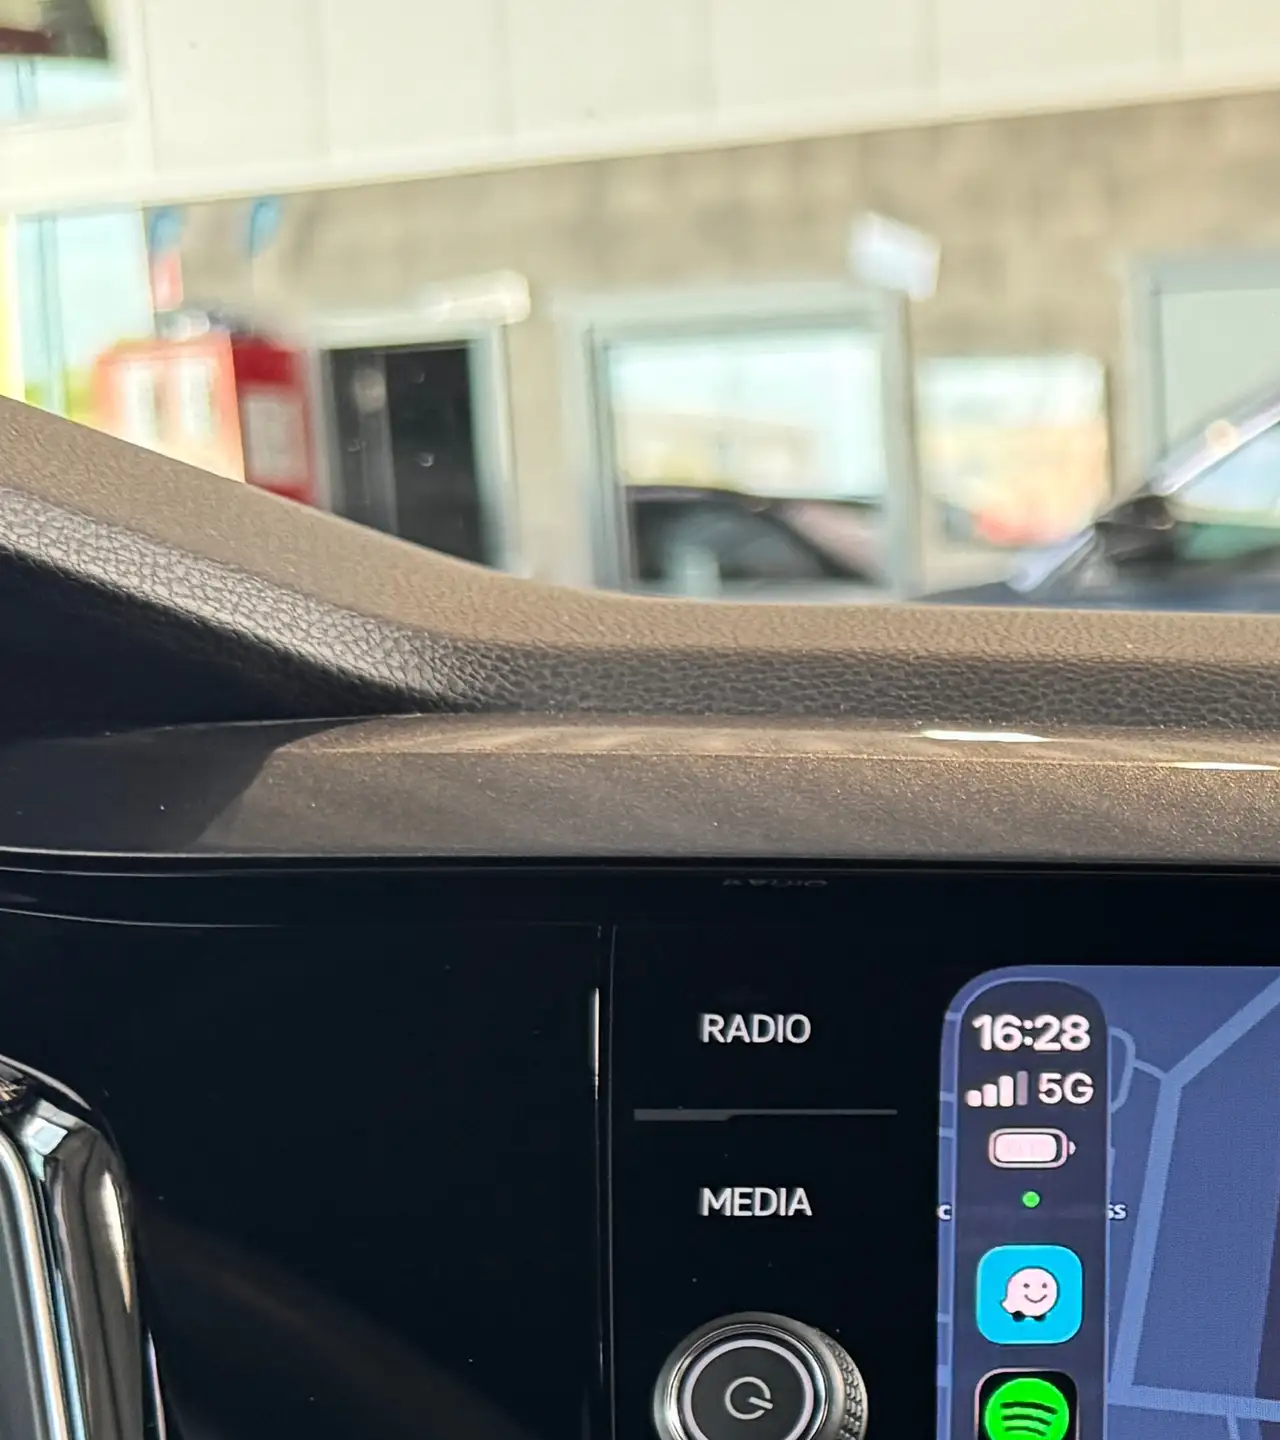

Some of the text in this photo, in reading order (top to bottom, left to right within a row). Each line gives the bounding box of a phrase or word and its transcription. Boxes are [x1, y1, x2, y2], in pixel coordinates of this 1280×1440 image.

[702, 1013, 811, 1044] RADIO
[972, 1014, 1091, 1051] 16:28
[1038, 1072, 1094, 1104] 5G
[702, 1187, 813, 1217] MEDIA
